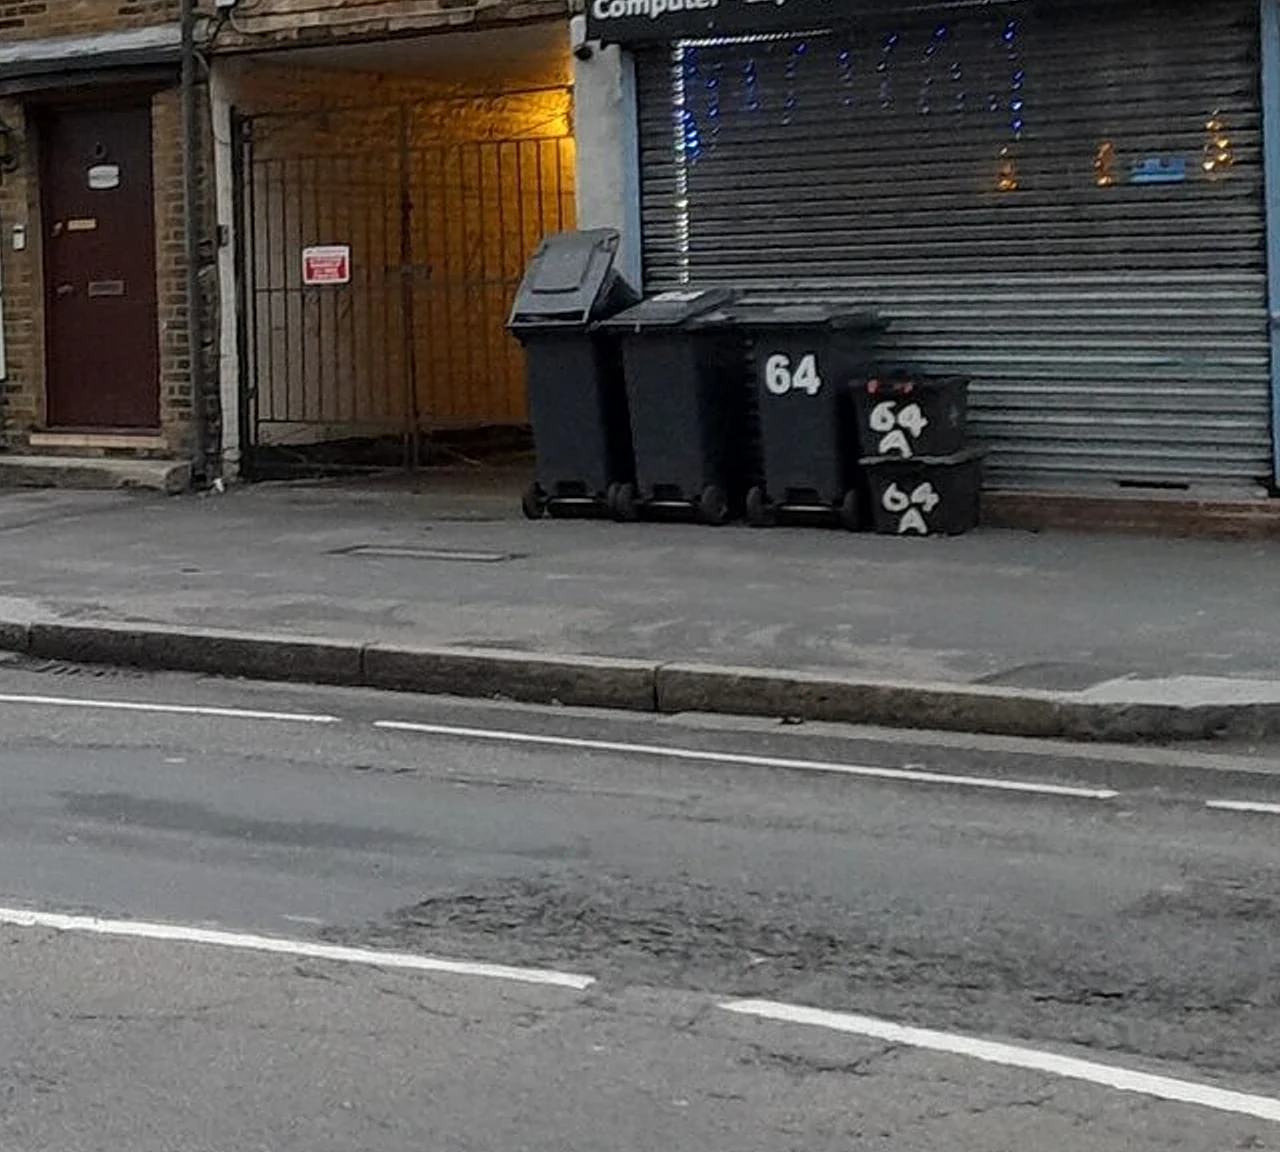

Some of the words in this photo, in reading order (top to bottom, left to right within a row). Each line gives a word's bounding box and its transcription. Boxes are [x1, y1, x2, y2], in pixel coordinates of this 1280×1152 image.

[765, 353, 821, 395] 64
[870, 400, 929, 438] 64
[878, 429, 913, 459] A
[882, 481, 939, 512] 64
[898, 507, 928, 535] A
